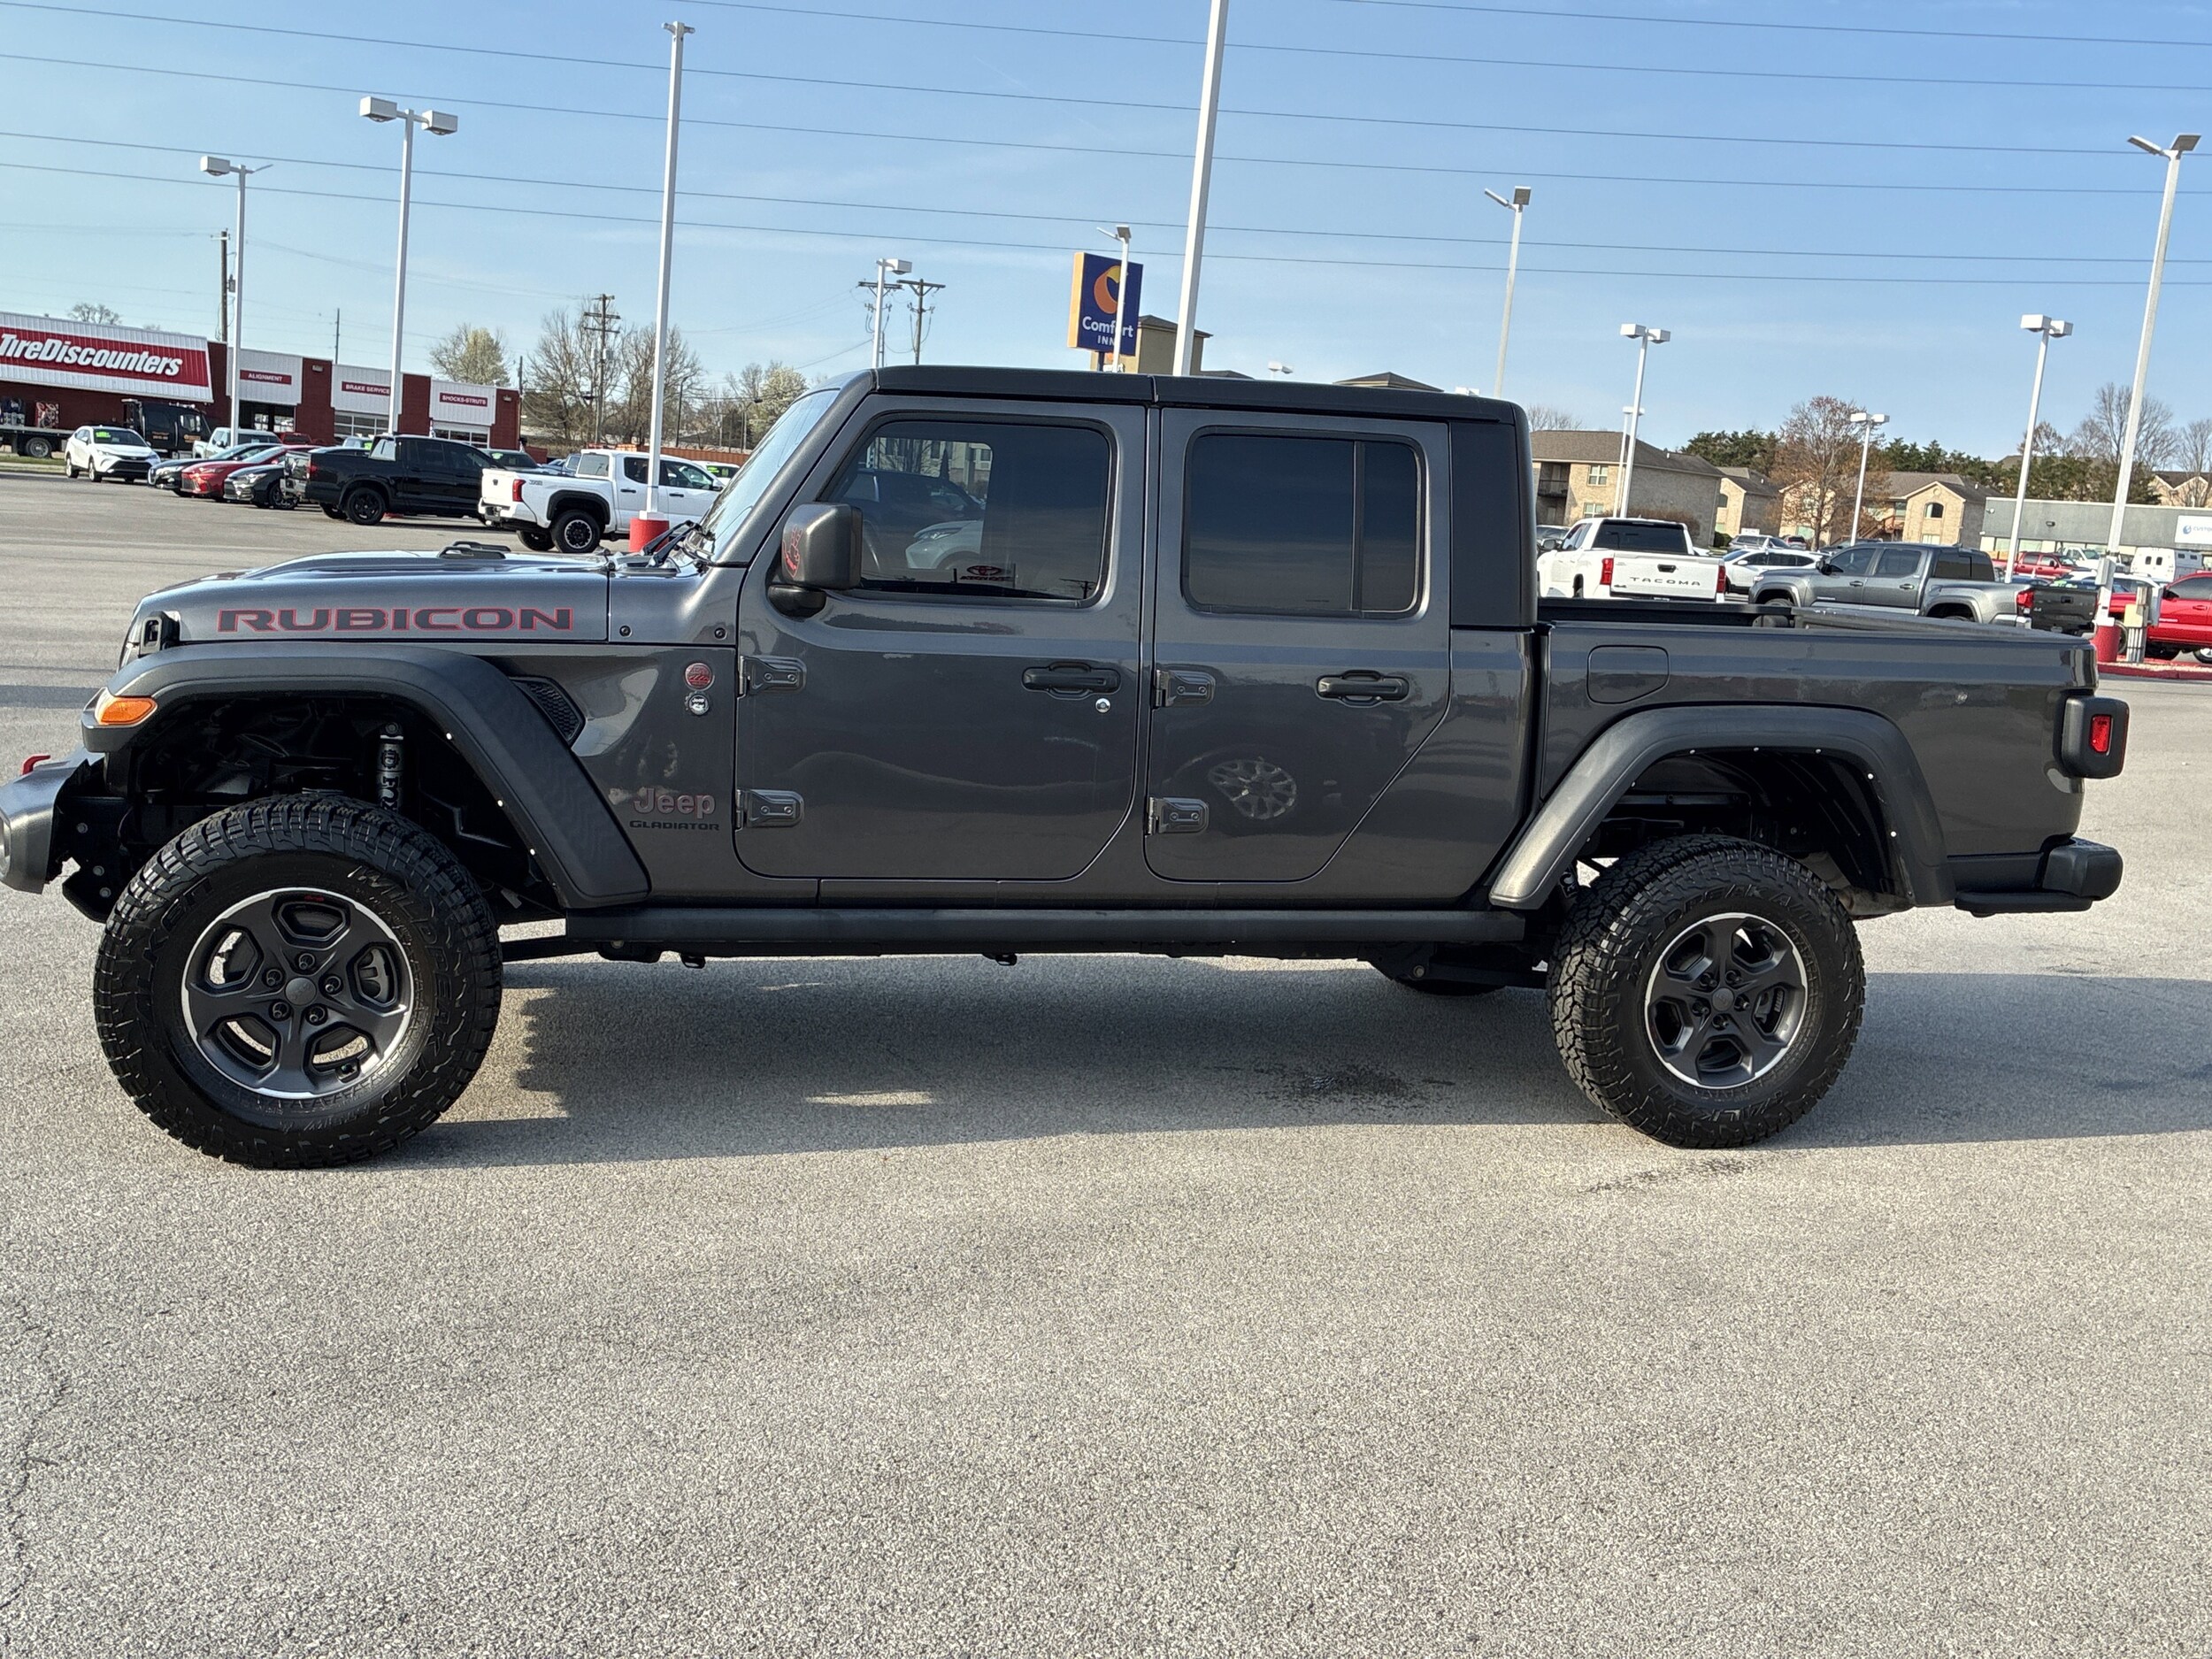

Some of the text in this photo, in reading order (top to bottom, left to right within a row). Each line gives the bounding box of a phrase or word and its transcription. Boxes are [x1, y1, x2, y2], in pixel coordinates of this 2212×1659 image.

[1082, 316, 1133, 337] Comfrt
[248, 373, 283, 382] ALIGNMENT
[345, 384, 390, 395] BRAKE SERVICE
[442, 395, 487, 405] SHOCKS-STRUTS
[1630, 576, 1701, 587] TACOMA
[218, 608, 573, 633] RUBICON
[634, 788, 716, 819] Jeep
[629, 820, 720, 831] GLADIATOR
